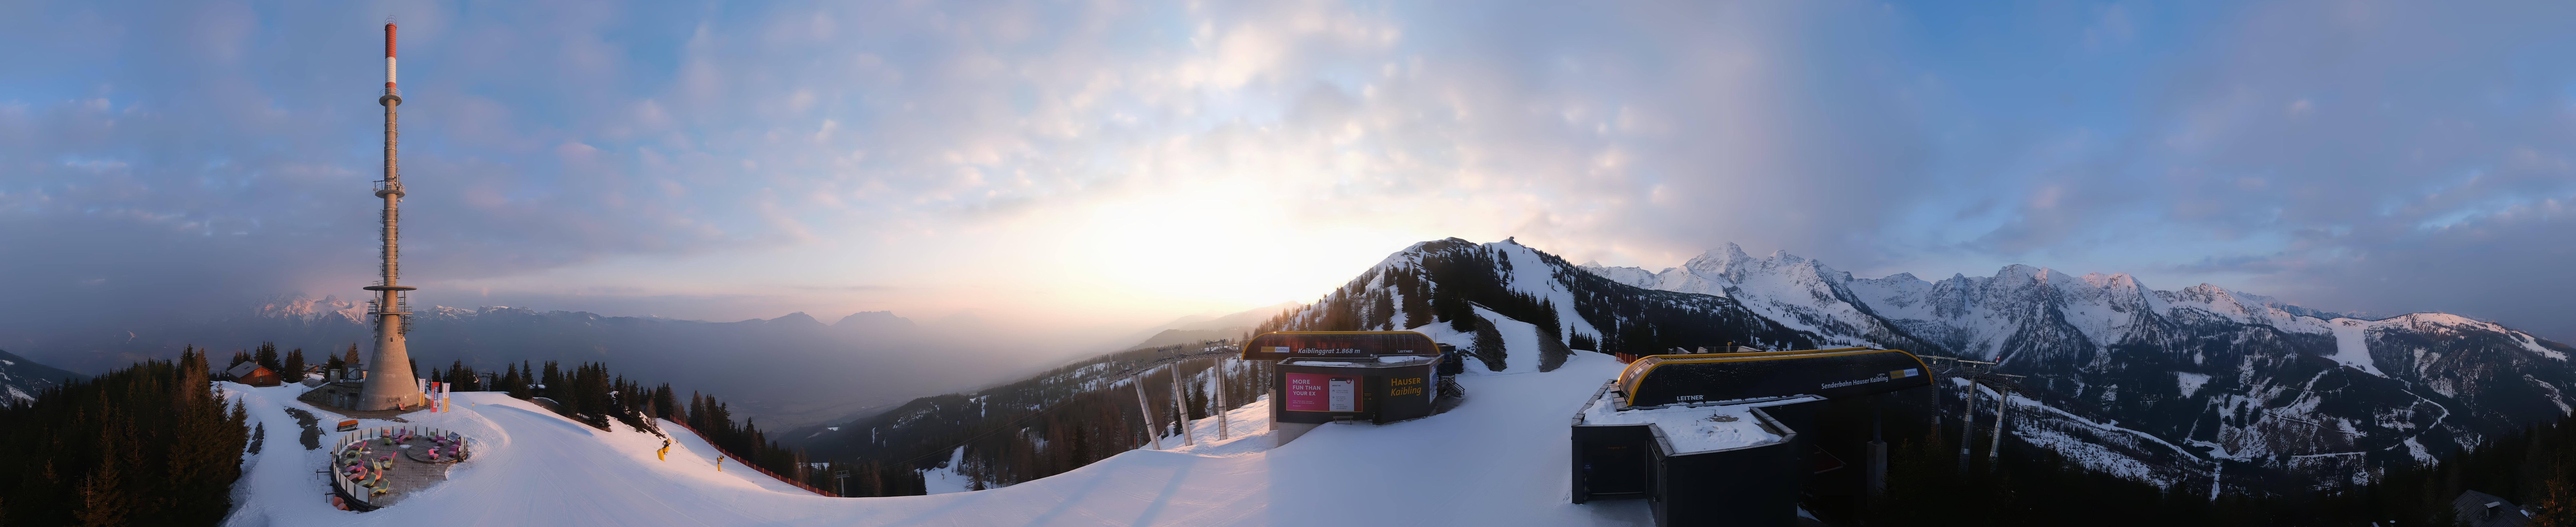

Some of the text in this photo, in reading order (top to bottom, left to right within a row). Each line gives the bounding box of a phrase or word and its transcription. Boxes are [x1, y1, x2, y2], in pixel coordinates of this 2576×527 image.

[1391, 378, 1421, 386] HAUSER
[1821, 380, 1852, 389] Senderbahn
[1391, 386, 1421, 396] Kaibling
